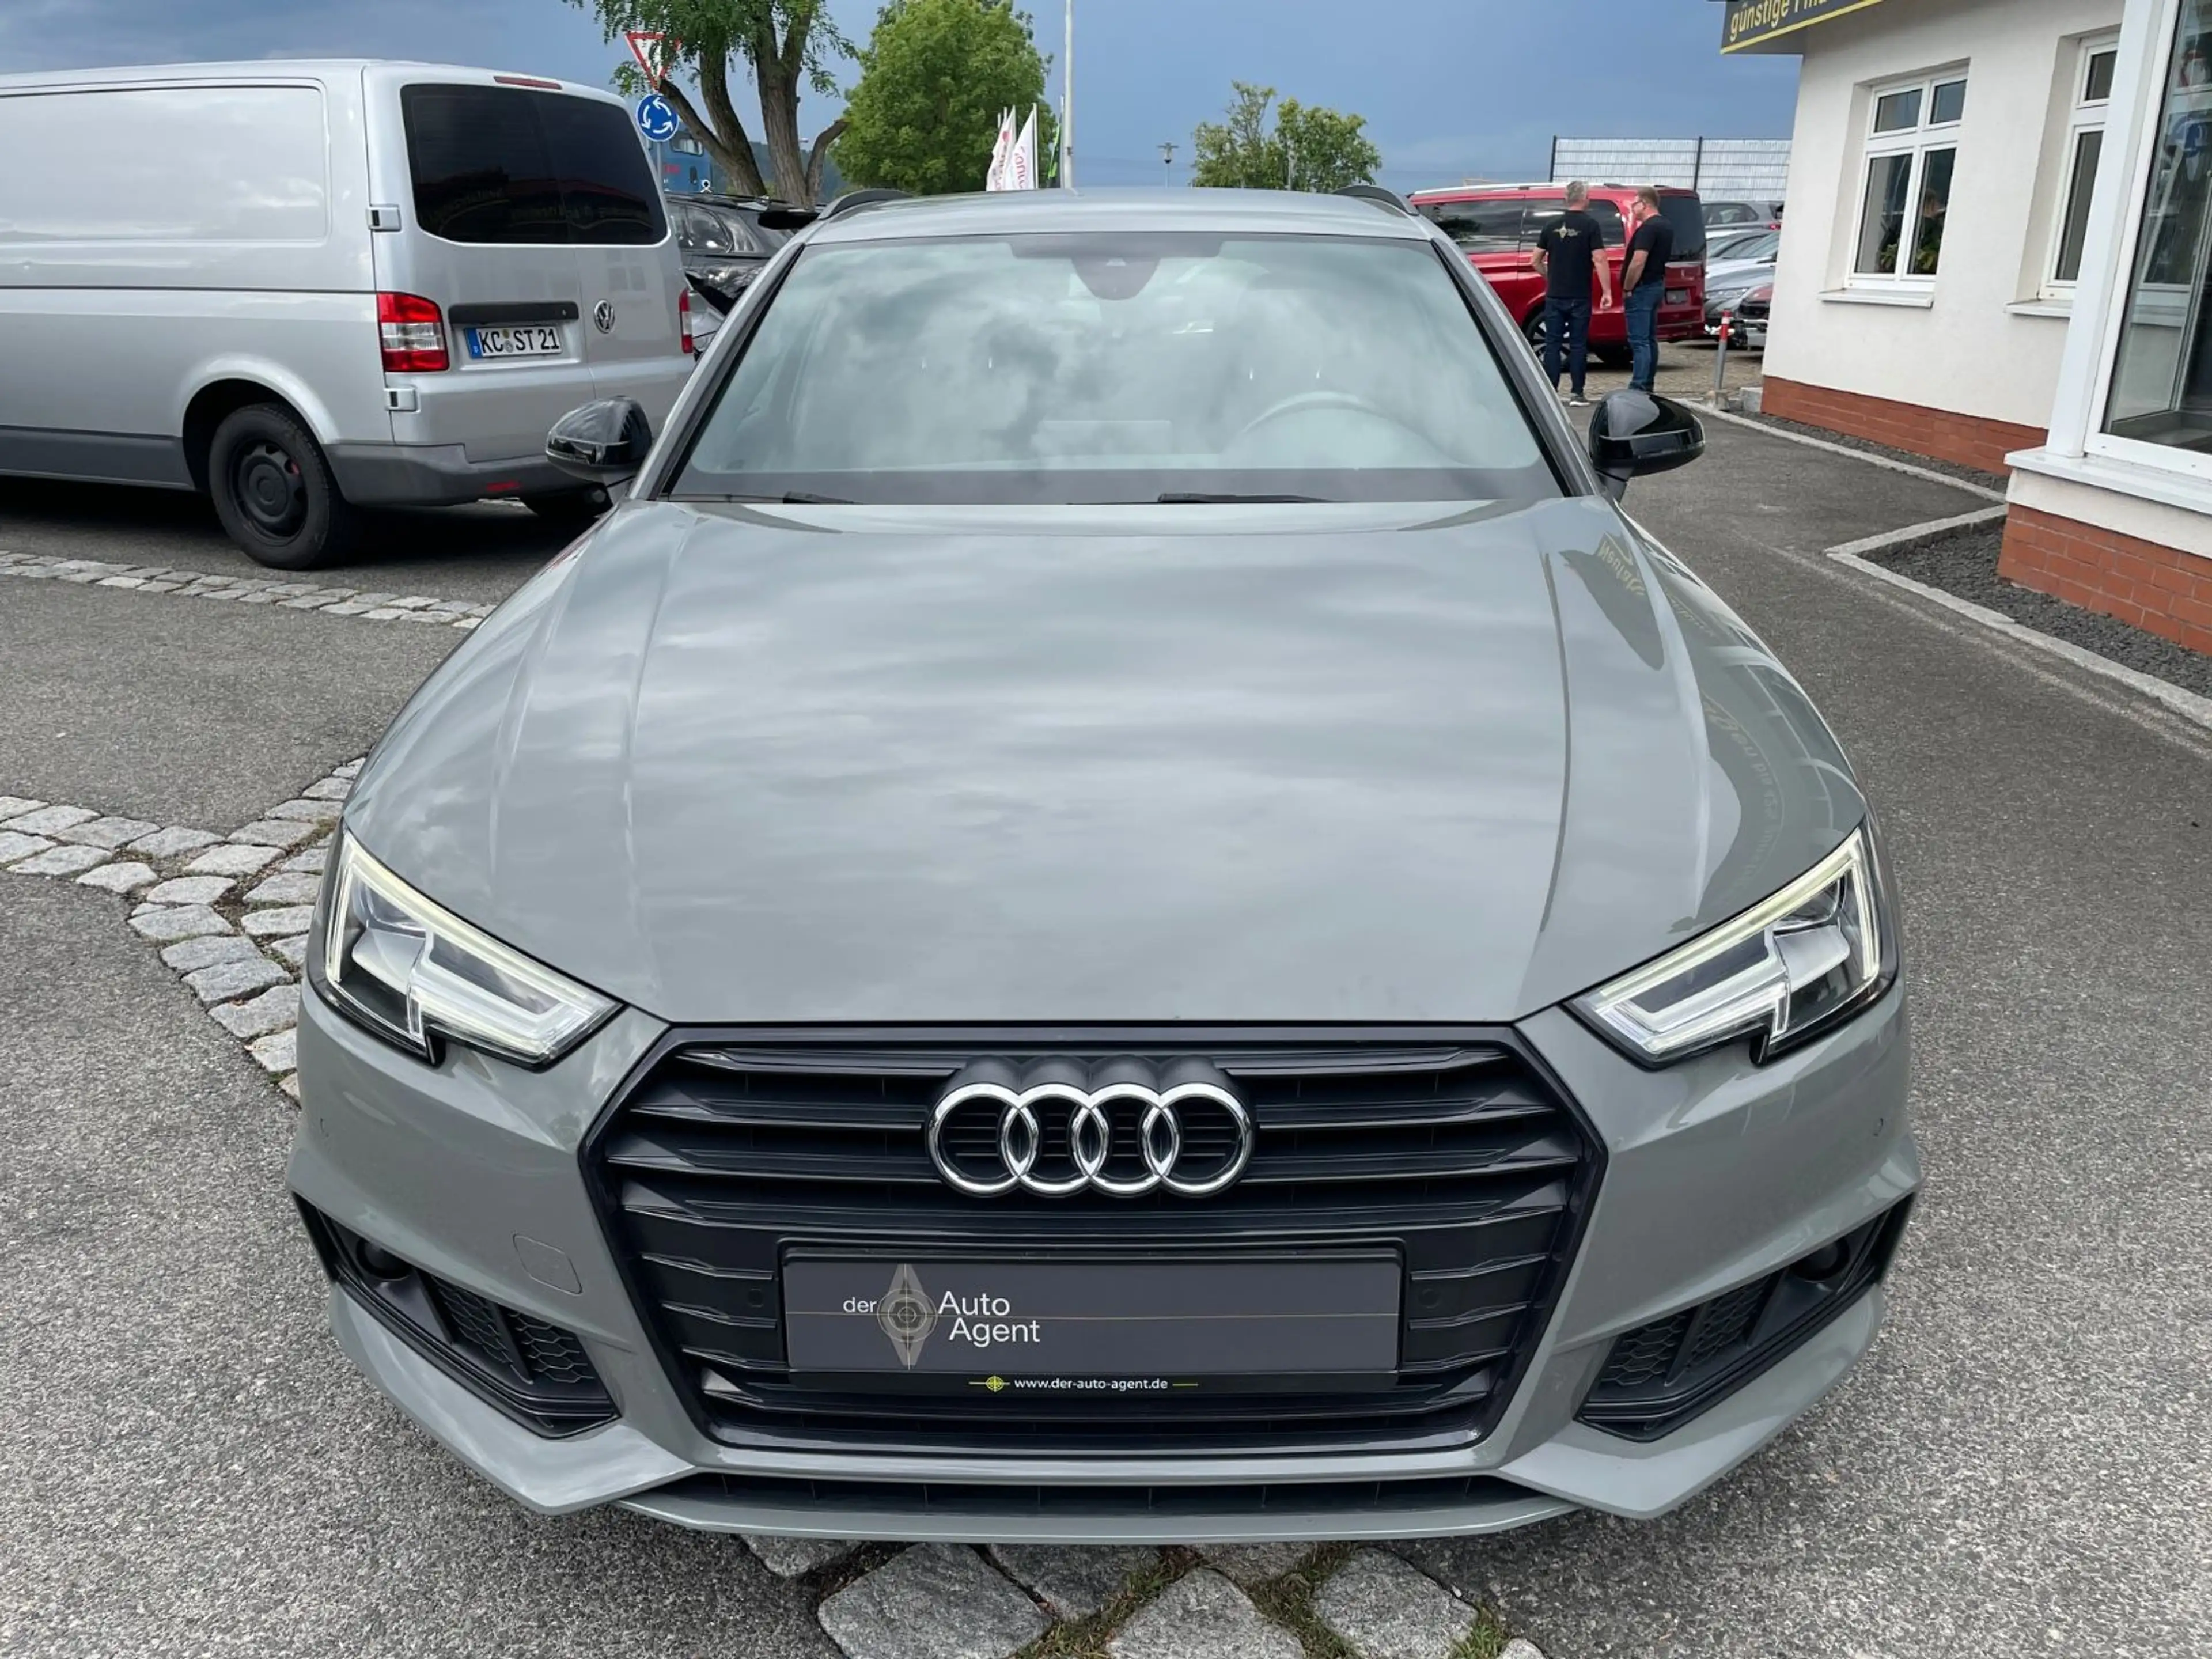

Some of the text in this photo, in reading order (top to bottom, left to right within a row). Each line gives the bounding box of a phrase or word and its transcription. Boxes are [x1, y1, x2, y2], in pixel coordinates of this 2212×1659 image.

[479, 328, 559, 353] KC ST 21
[843, 1291, 1010, 1316] der Auto
[949, 1317, 1040, 1348] Agent
[1014, 1378, 1168, 1392] www.der-auto-agent.de
